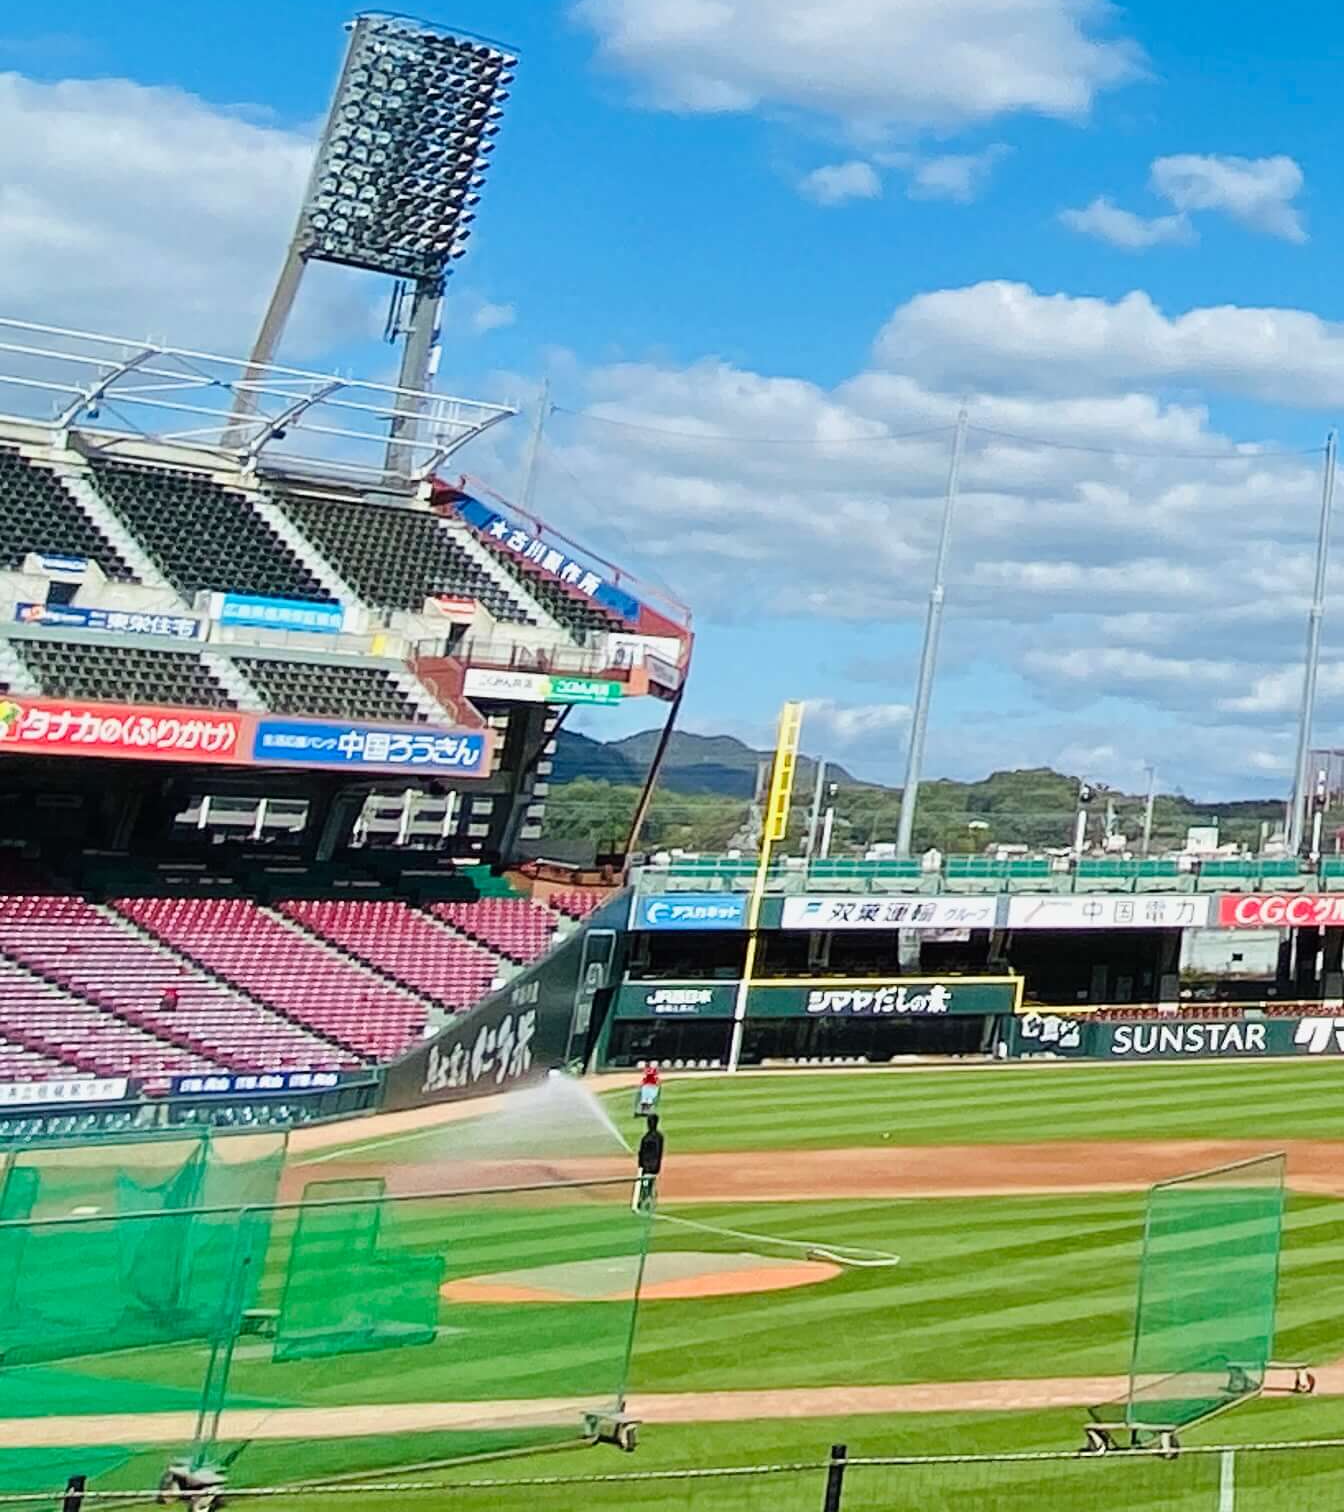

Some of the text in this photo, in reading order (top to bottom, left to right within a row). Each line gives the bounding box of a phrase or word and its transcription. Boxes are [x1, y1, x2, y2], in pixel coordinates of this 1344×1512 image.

[338, 729, 479, 766] 中国ろうきん
[830, 901, 991, 923] 双葉運輸 グループ
[1082, 898, 1196, 923] 中国電力
[806, 984, 951, 1013] シマヤだしの素
[1111, 1023, 1266, 1054] SUNSTAR
